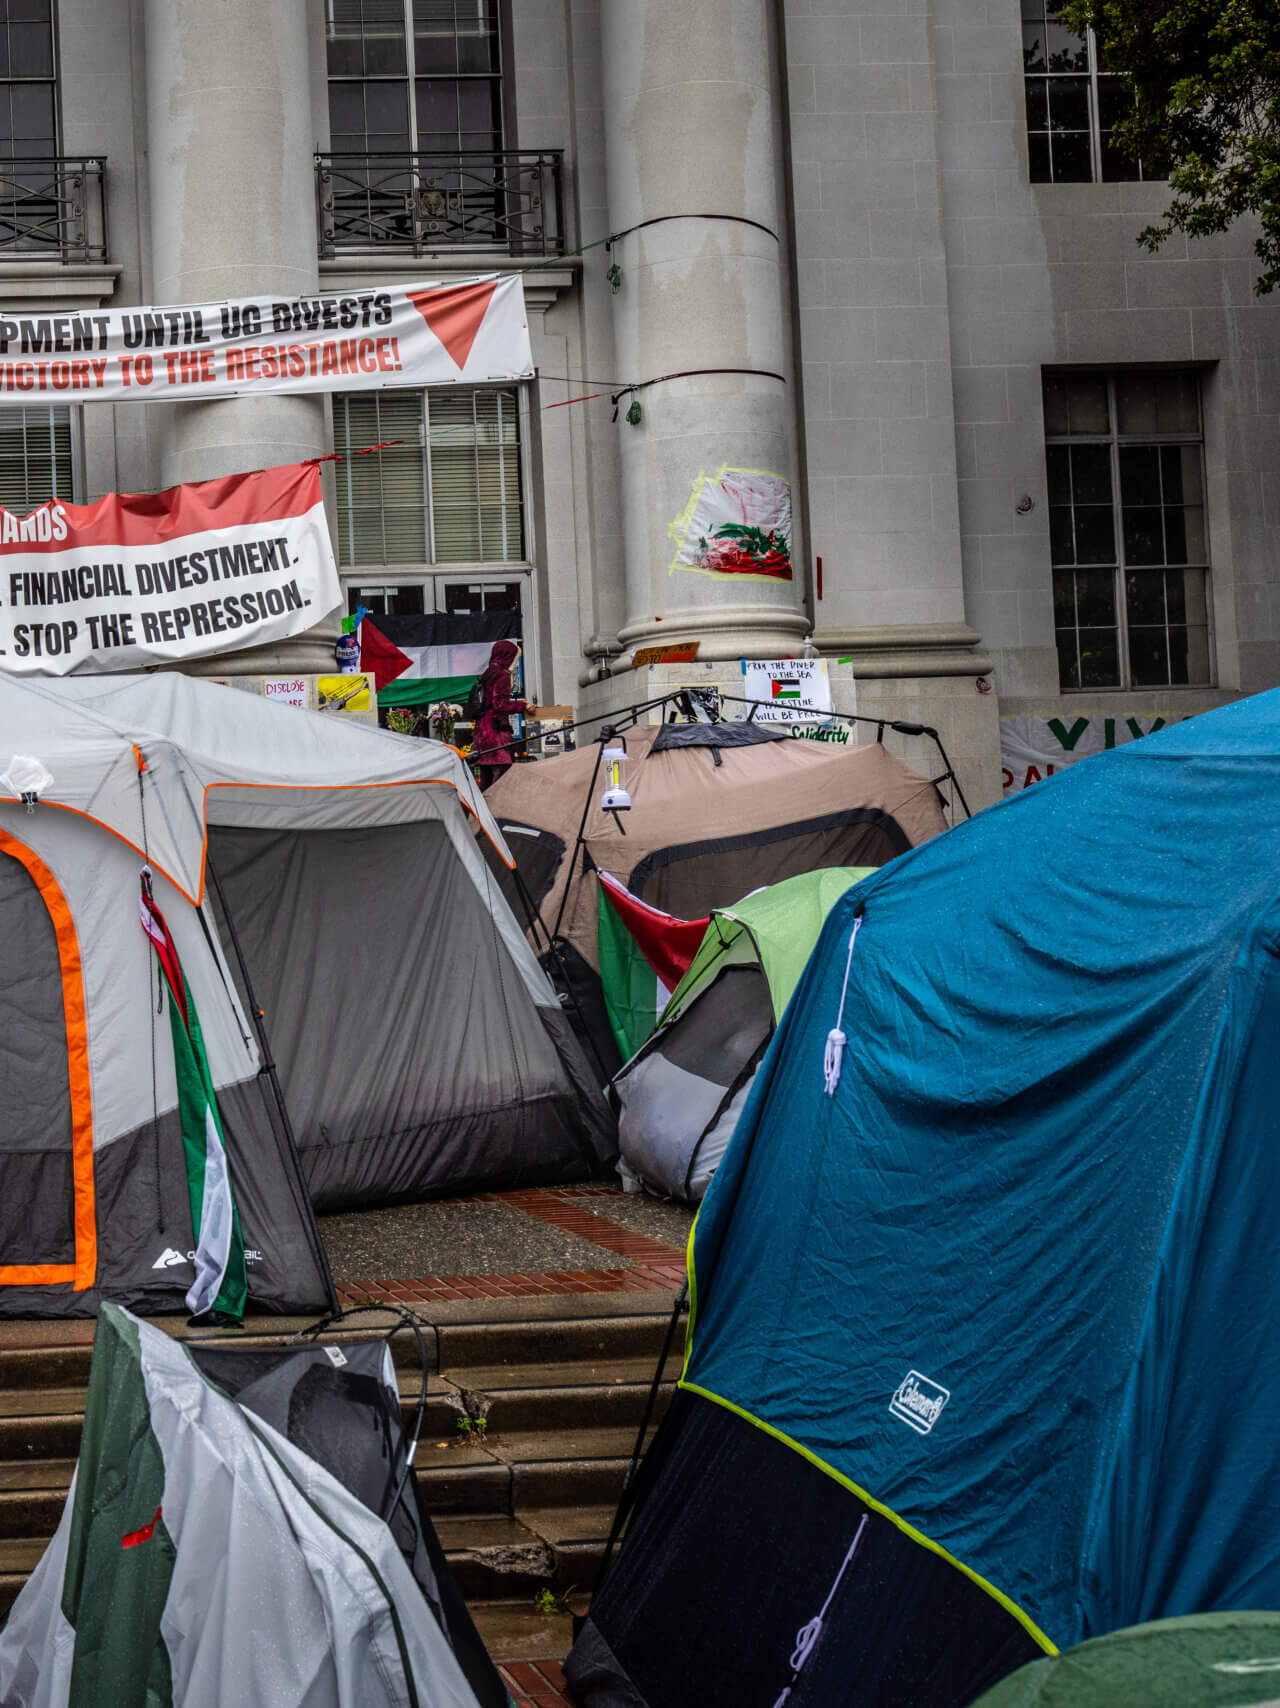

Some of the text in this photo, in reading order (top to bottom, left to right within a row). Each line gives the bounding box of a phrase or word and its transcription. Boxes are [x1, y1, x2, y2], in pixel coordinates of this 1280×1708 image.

[122, 311, 210, 348] UNTIL
[271, 293, 392, 332] DIVESTS
[117, 354, 154, 387] TO
[163, 349, 216, 383] THE
[226, 337, 402, 380] RESISTANCE!
[10, 563, 132, 607] FINANCIAL
[135, 537, 299, 596] DIVESTMENT.
[14, 623, 77, 657] STOP
[85, 614, 136, 650] THE
[141, 580, 312, 643] REPRESSION.
[771, 662, 785, 670] THE
[797, 670, 812, 679] SEA
[755, 712, 778, 720] WILL
[781, 711, 792, 719] BE
